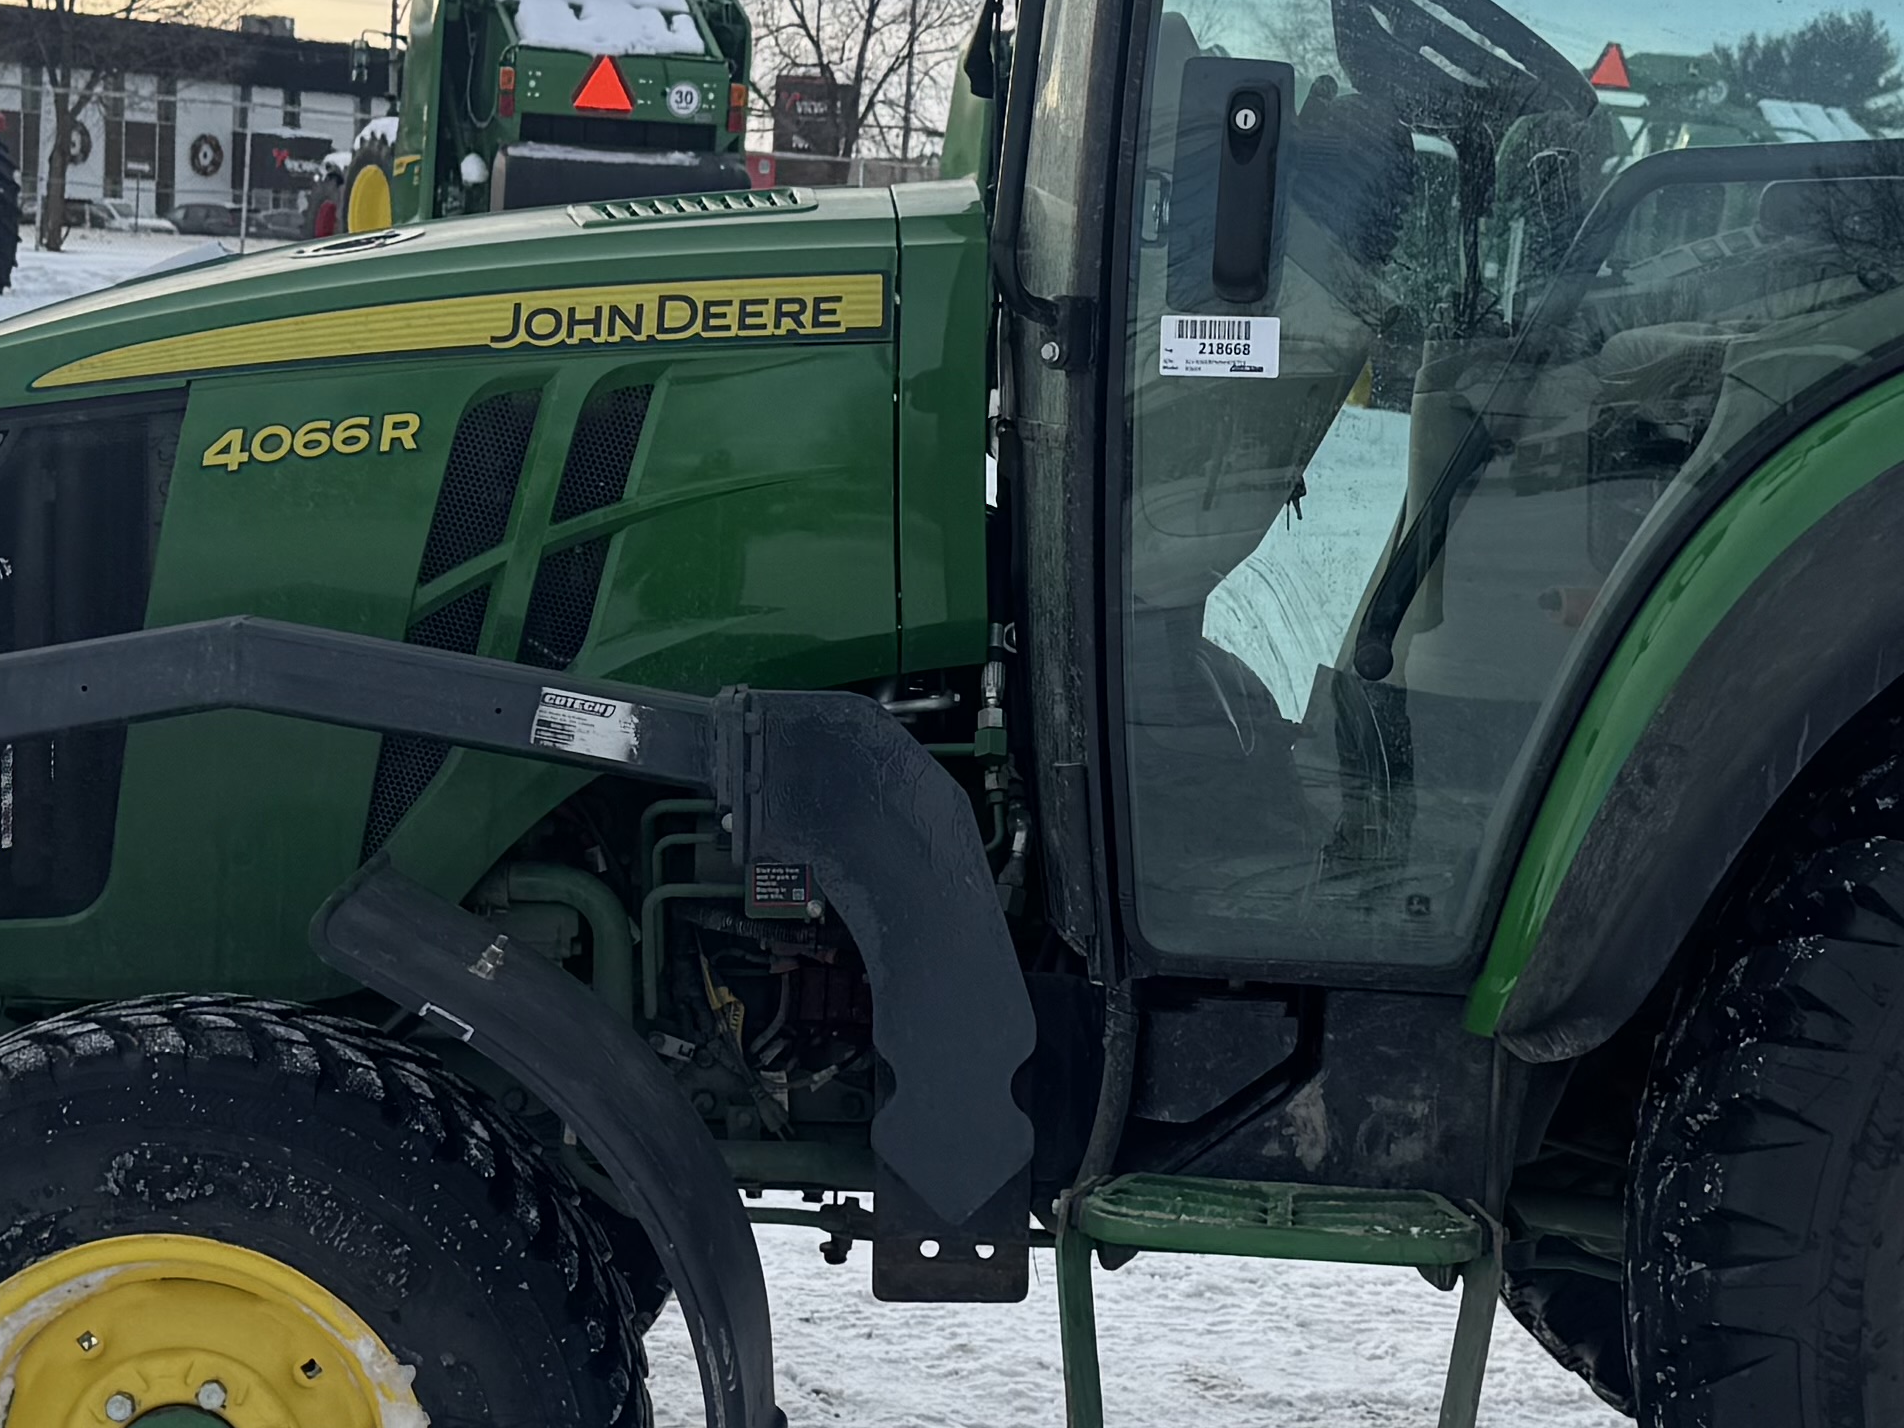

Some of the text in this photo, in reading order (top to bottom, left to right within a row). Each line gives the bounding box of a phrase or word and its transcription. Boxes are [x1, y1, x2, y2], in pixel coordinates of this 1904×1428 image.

[674, 89, 694, 105] 30
[489, 294, 844, 345] JOHN DEERE
[1198, 342, 1251, 356] 218668
[201, 411, 422, 472] 4066R
